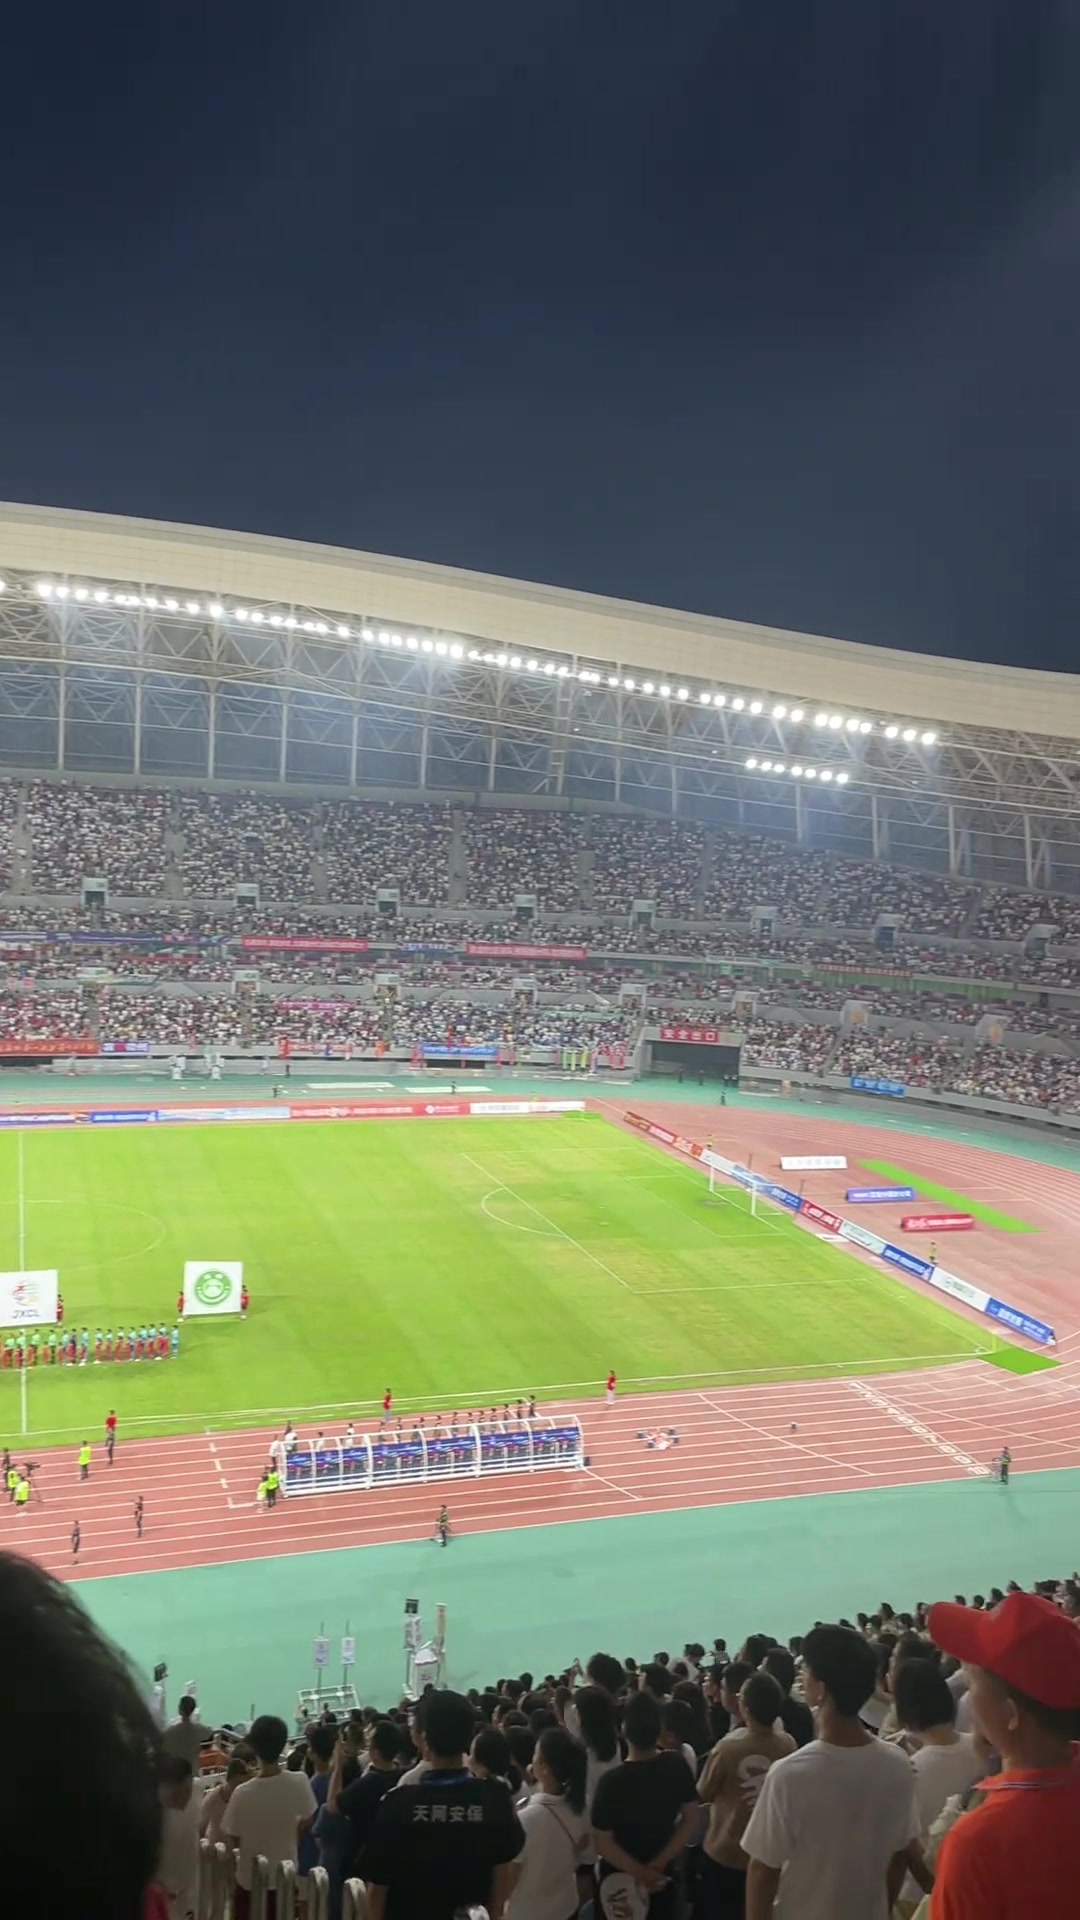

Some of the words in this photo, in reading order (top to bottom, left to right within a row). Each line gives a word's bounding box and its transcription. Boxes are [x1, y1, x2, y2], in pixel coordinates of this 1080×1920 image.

[663, 1029, 716, 1041] 安全出口
[924, 1435, 938, 1443] 7
